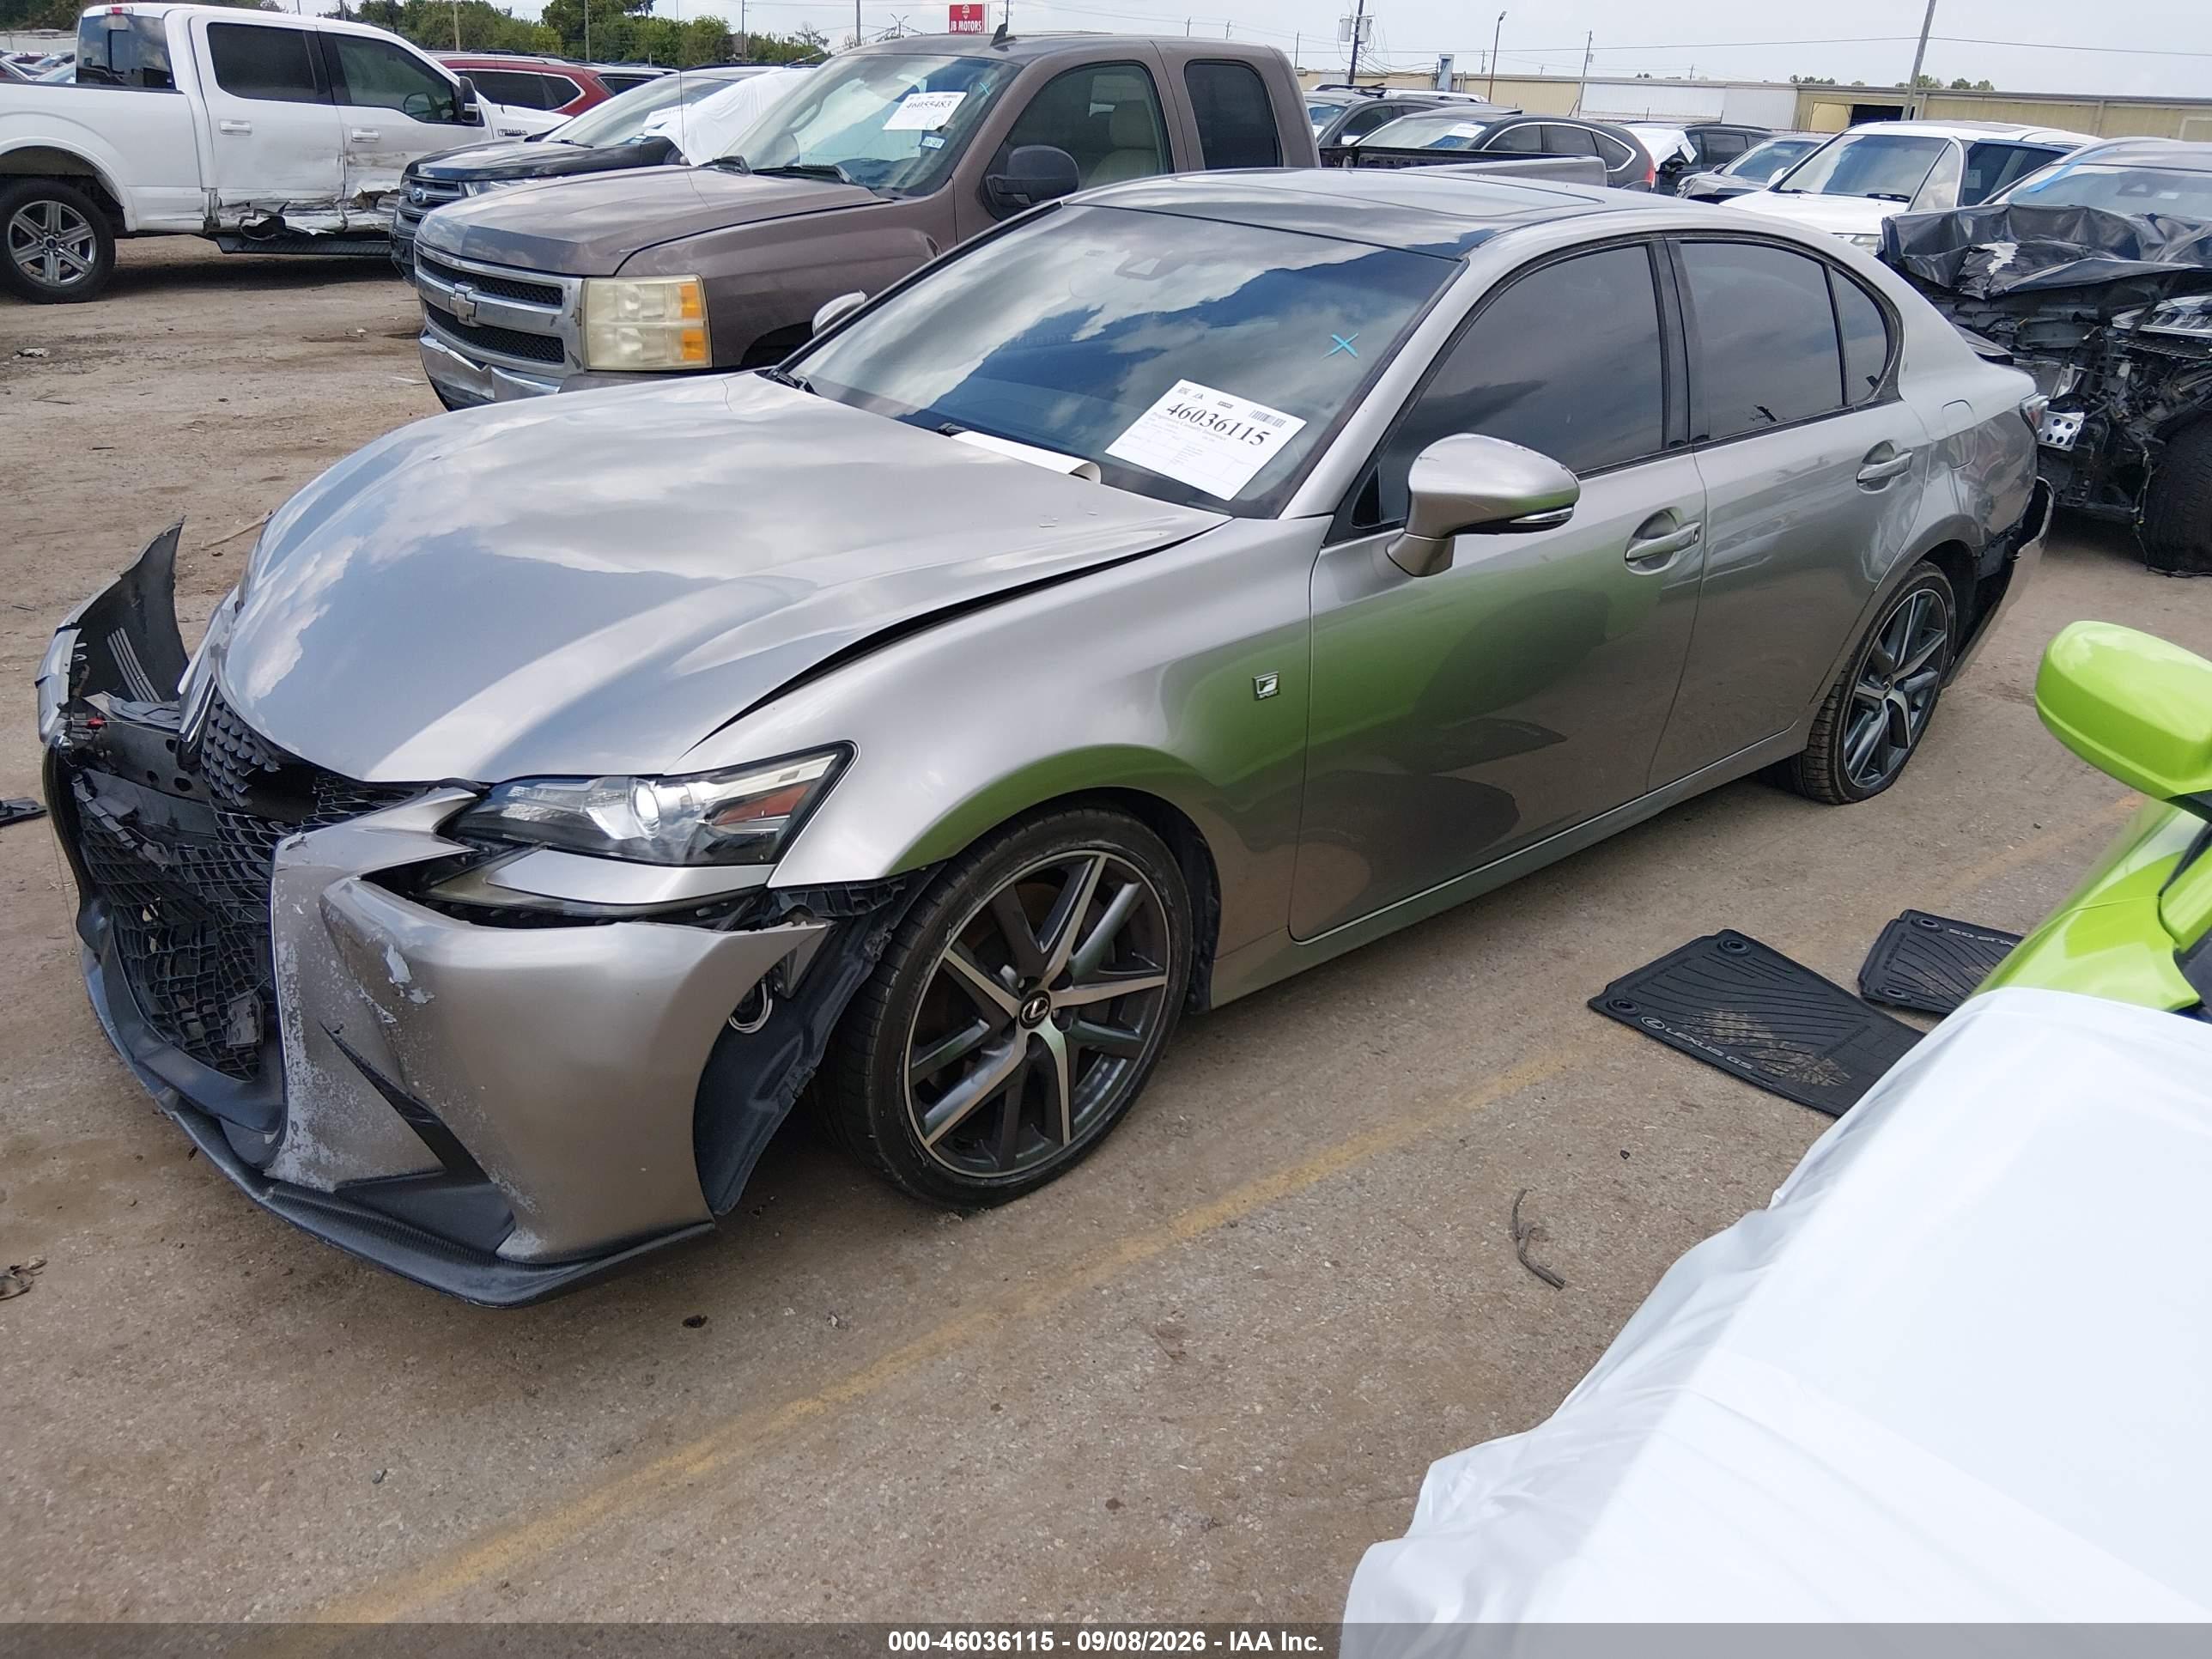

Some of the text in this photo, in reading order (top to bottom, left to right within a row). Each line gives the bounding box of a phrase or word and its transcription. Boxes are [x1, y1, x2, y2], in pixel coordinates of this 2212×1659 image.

[958, 20, 981, 32] MOTORS
[1167, 403, 1271, 446] 46036115
[1666, 1028, 1724, 1057] LEXUS
[1725, 1055, 1753, 1070] GS
